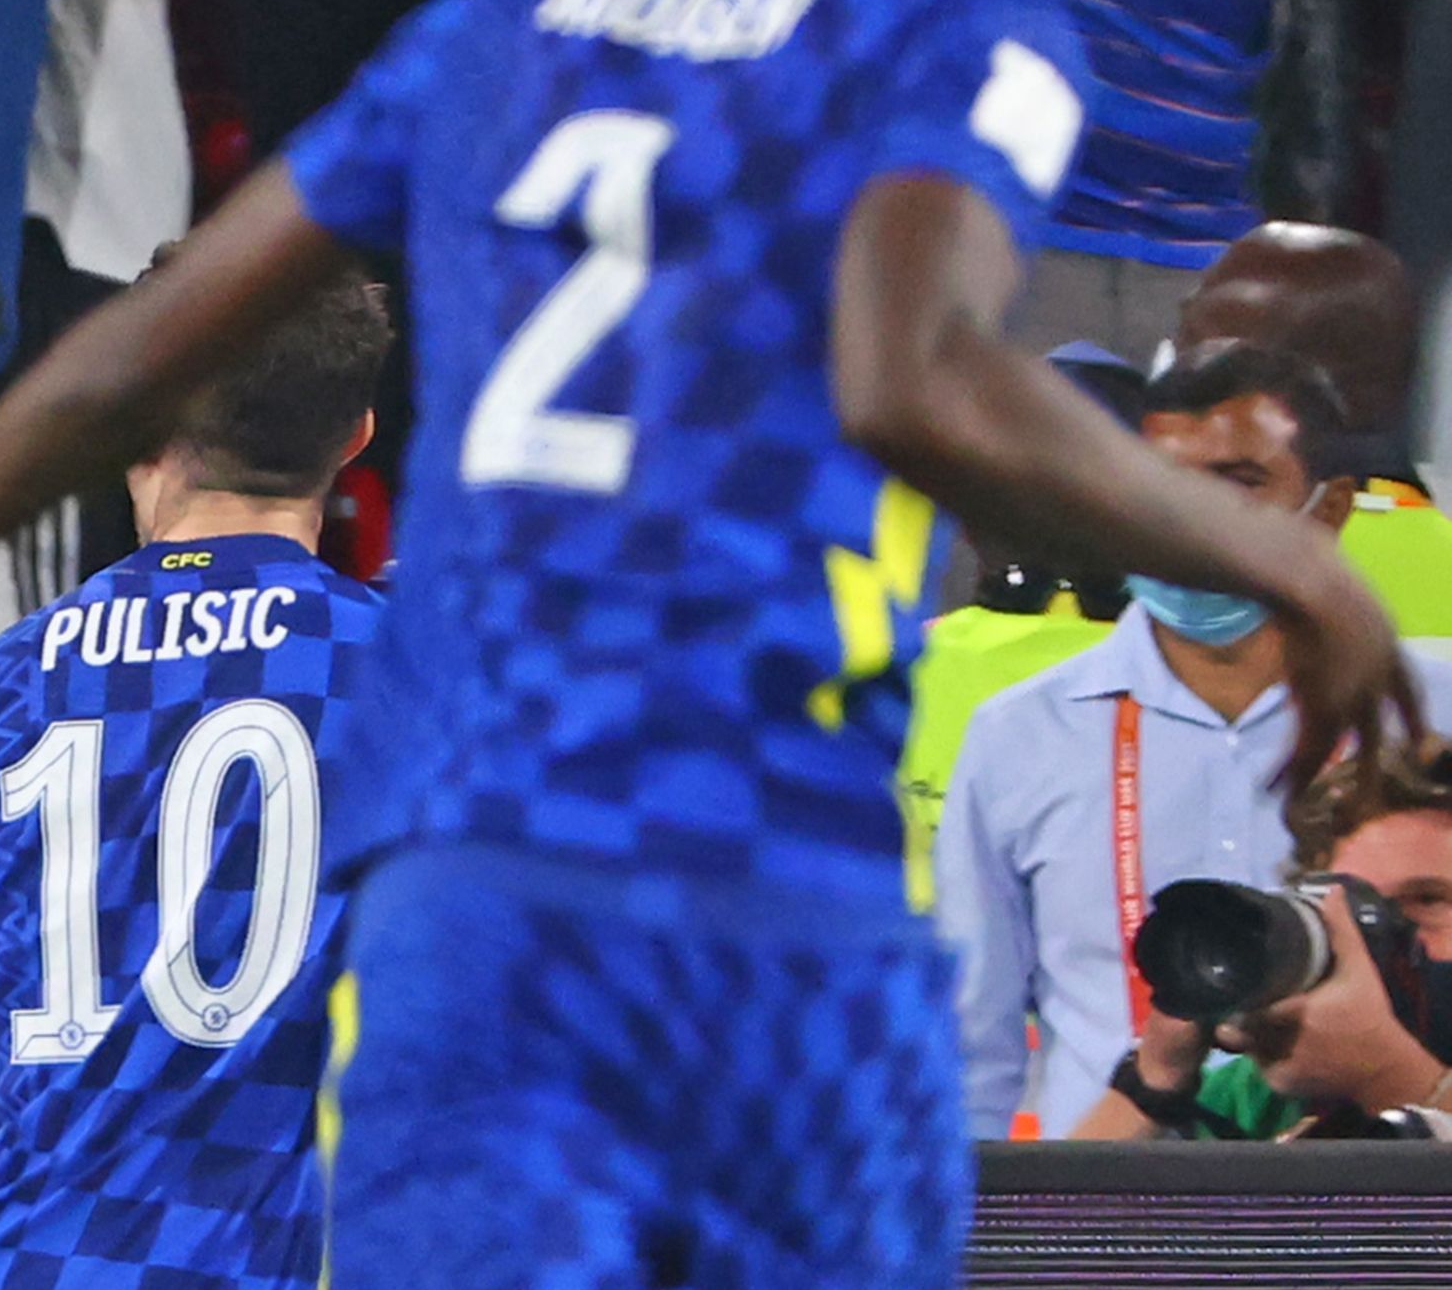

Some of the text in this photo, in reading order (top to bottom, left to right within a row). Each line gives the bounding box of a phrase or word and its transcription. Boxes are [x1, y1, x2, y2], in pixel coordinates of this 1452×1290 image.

[460, 108, 677, 493] 2
[161, 552, 212, 569] CFC
[41, 586, 296, 671] PULISIC
